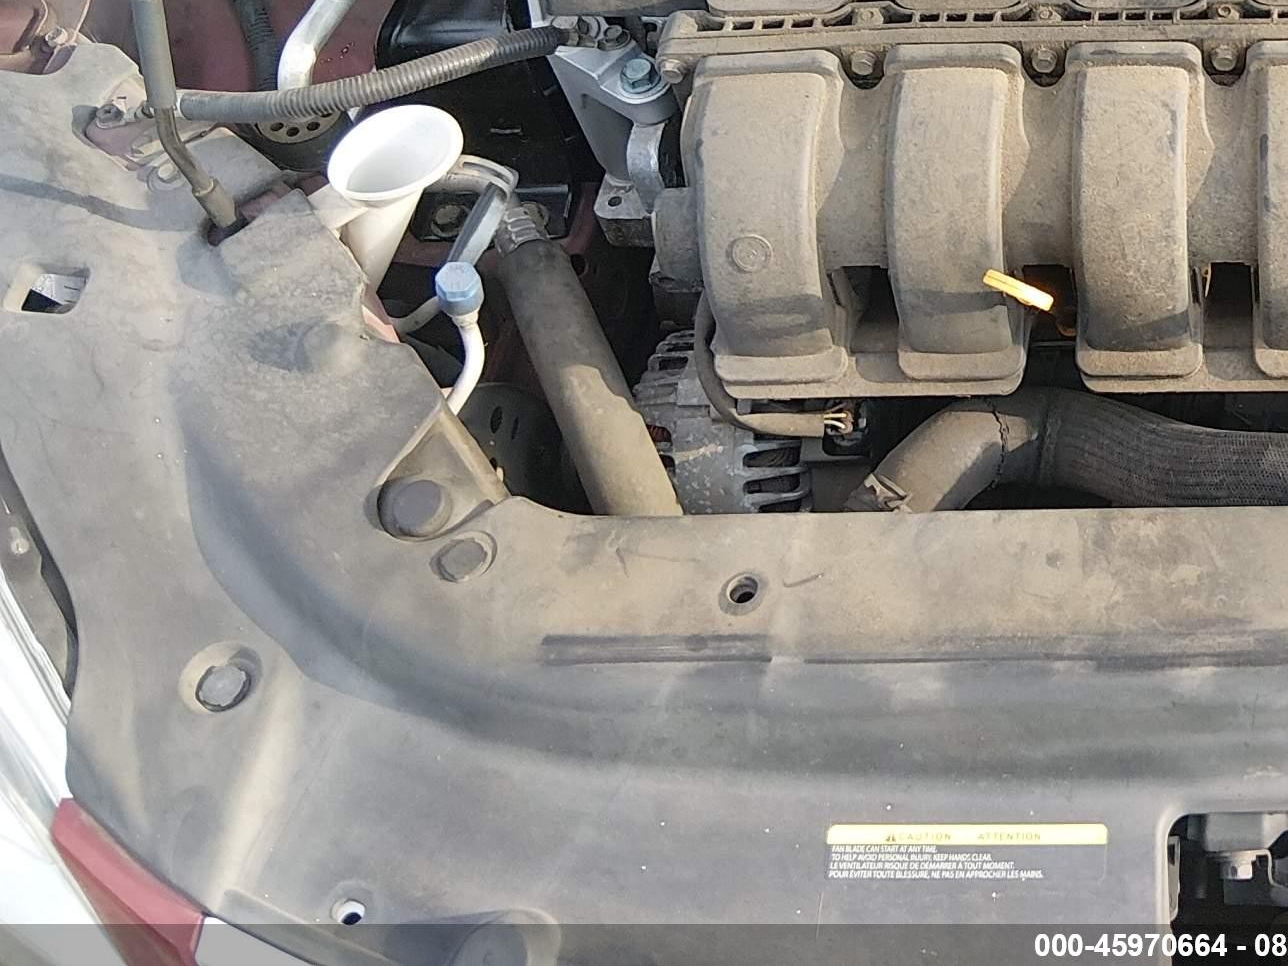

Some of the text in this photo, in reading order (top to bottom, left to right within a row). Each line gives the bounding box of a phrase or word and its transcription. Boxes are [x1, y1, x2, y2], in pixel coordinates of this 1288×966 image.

[899, 833, 1041, 841] CAUTION ATTENTION
[832, 845, 845, 853] FAN
[845, 845, 865, 853] BLADE
[866, 845, 880, 853] CAN
[880, 845, 899, 853] START
[900, 845, 908, 853] AT
[908, 845, 921, 853] ANY
[832, 853, 841, 861] TO
[842, 853, 858, 861] HELP
[858, 853, 878, 861] AVOID
[878, 853, 910, 861] PERSONAL
[933, 853, 949, 861] KEEP
[949, 853, 971, 861] HANDS
[830, 861, 839, 870] LE
[840, 861, 884, 870] VENTILATEUR
[884, 861, 908, 870] RISQUE
[910, 861, 919, 870] DE
[920, 860, 957, 870] DÉMARRER
[964, 861, 982, 870] TOUT
[983, 861, 1015, 870] MOMENT.
[829, 870, 850, 879] POUR
[850, 870, 873, 879] ÉVITER
[873, 870, 895, 879] TOUTE
[931, 870, 941, 879] NE
[942, 870, 955, 879] PAS
[956, 870, 965, 879] EN
[965, 870, 1006, 879] APPROCHER
[1007, 870, 1019, 879] LES
